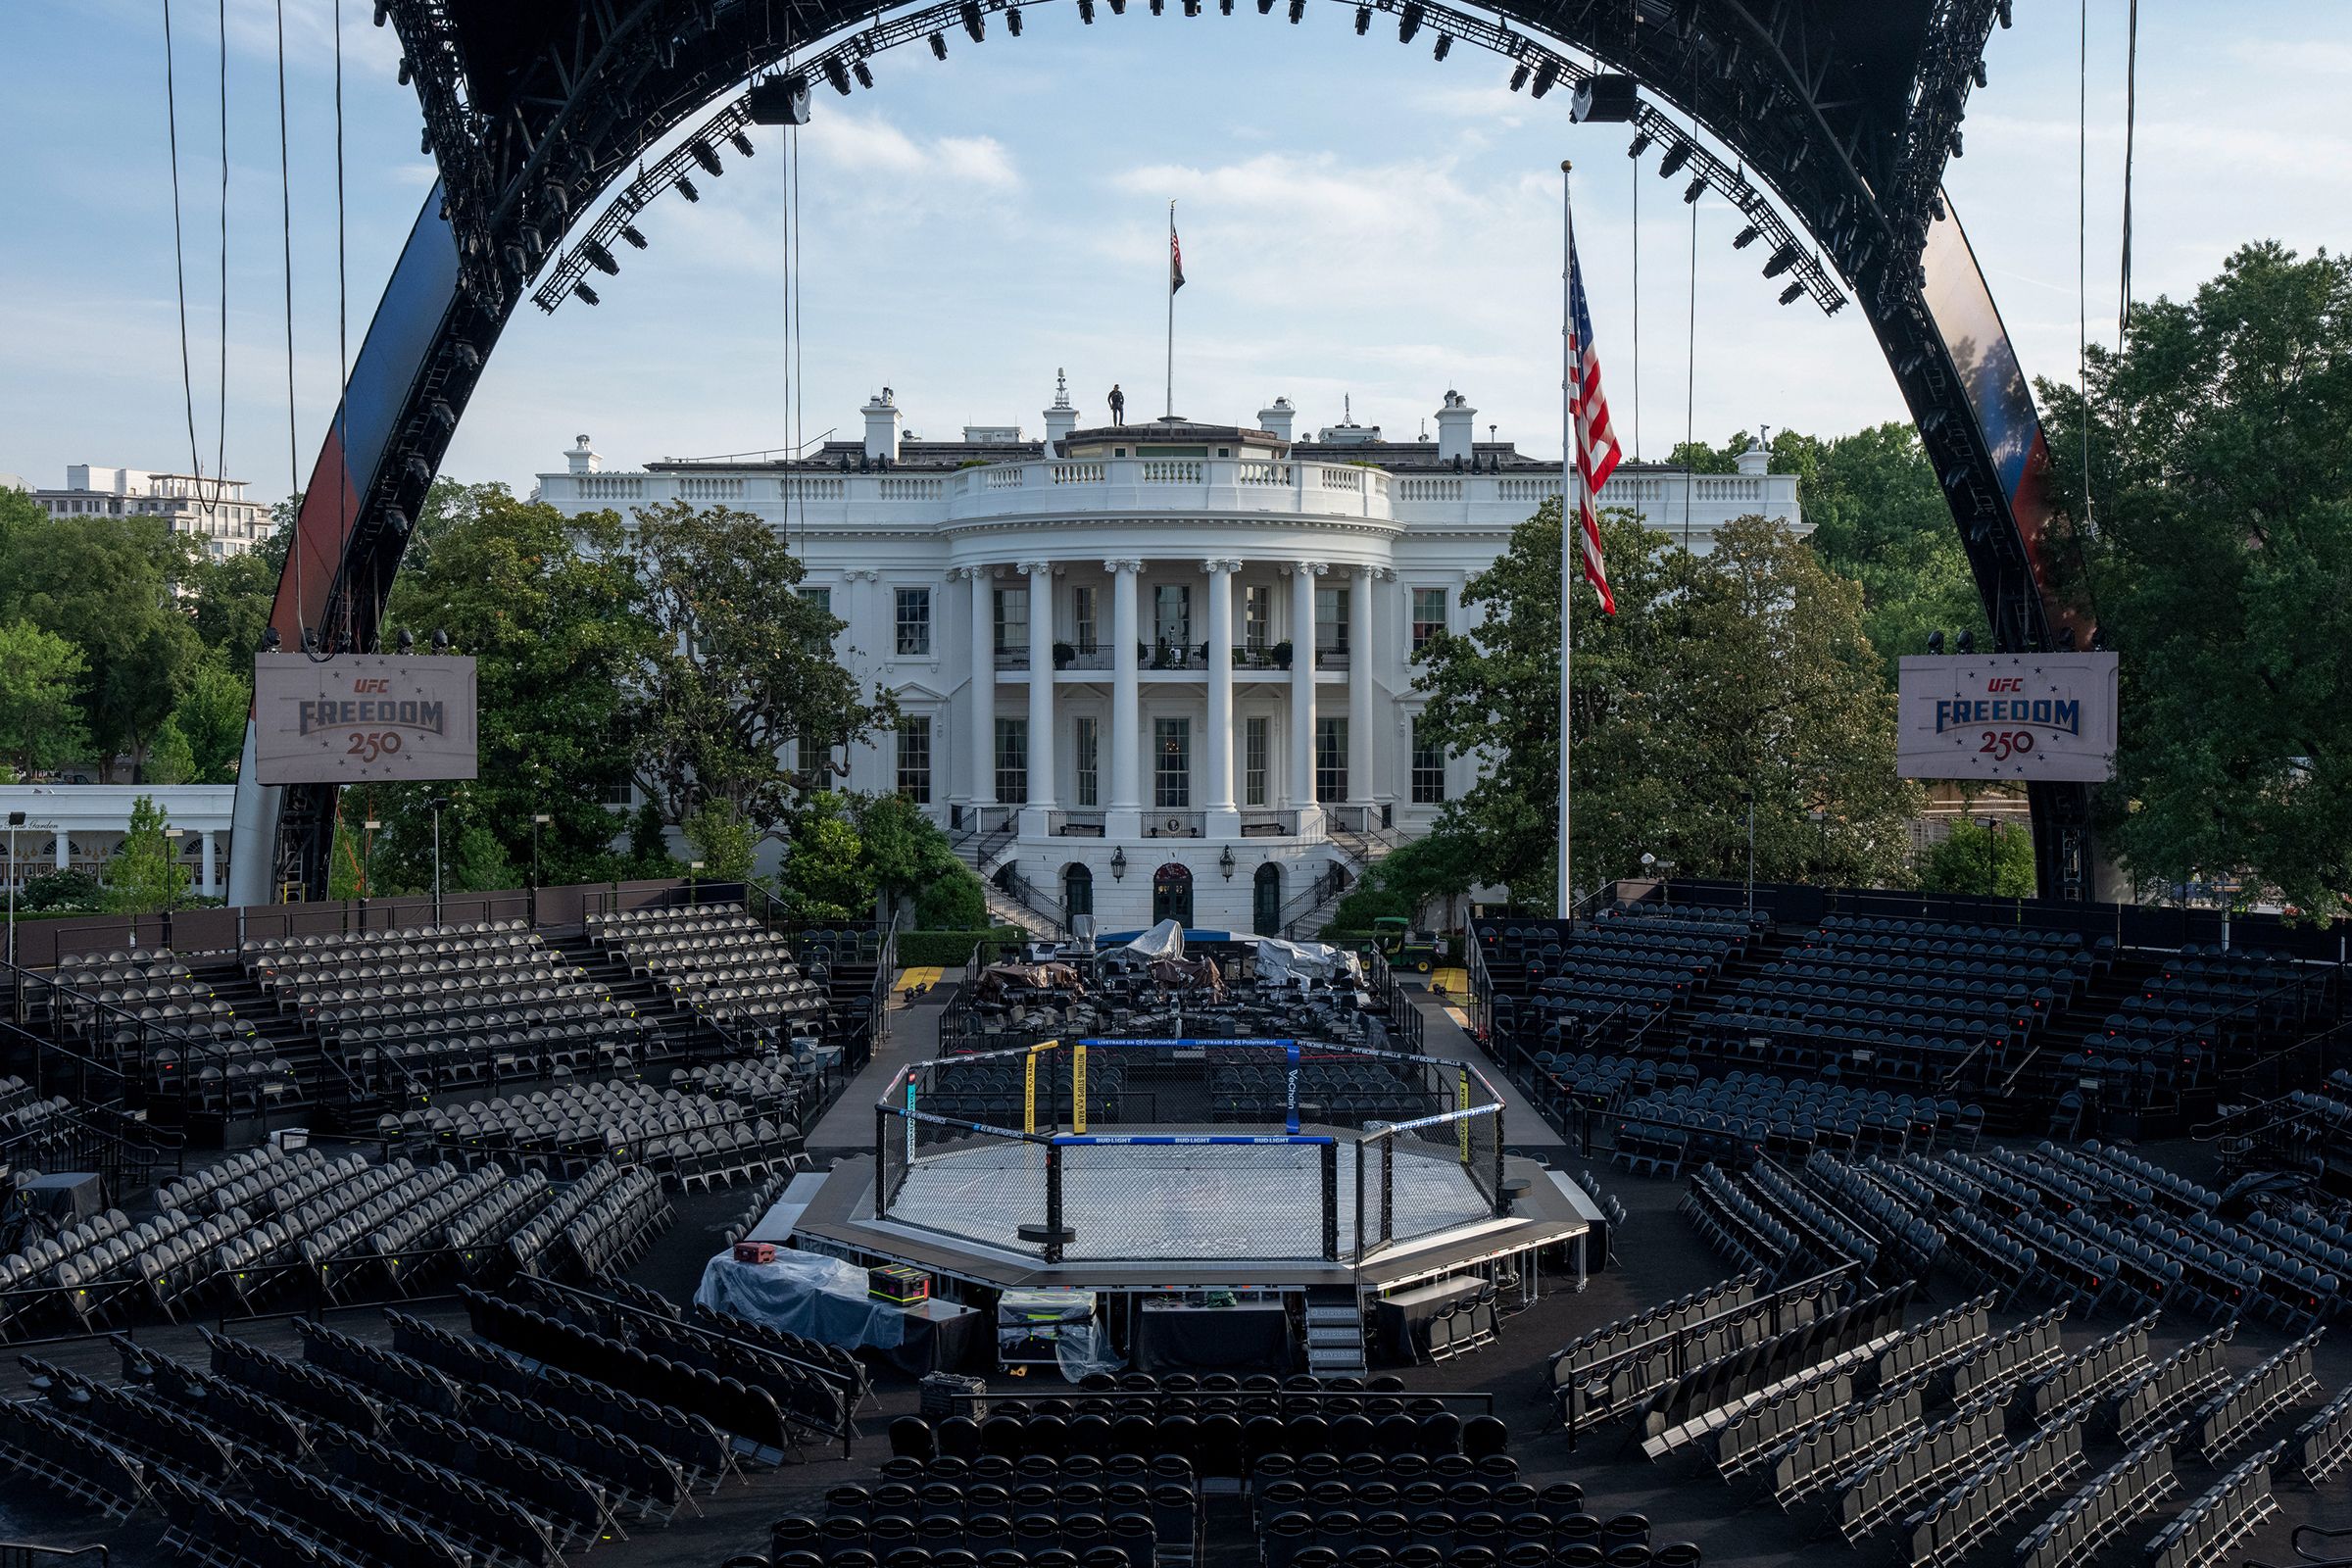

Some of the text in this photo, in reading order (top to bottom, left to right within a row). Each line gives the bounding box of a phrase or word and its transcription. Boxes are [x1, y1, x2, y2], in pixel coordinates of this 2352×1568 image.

[354, 678, 390, 693] UFC
[1987, 678, 2024, 692] UFC
[299, 701, 443, 737] FREEDOM
[1936, 700, 2080, 735] FREEDOM
[347, 731, 402, 763] 250
[1979, 731, 2034, 761] 250
[28, 819, 59, 829] Garden
[1288, 1069, 1298, 1109] VeChain
[916, 1113, 946, 1124] ORTHOPEDICS
[992, 1127, 1024, 1139] ORTHOPEDICS
